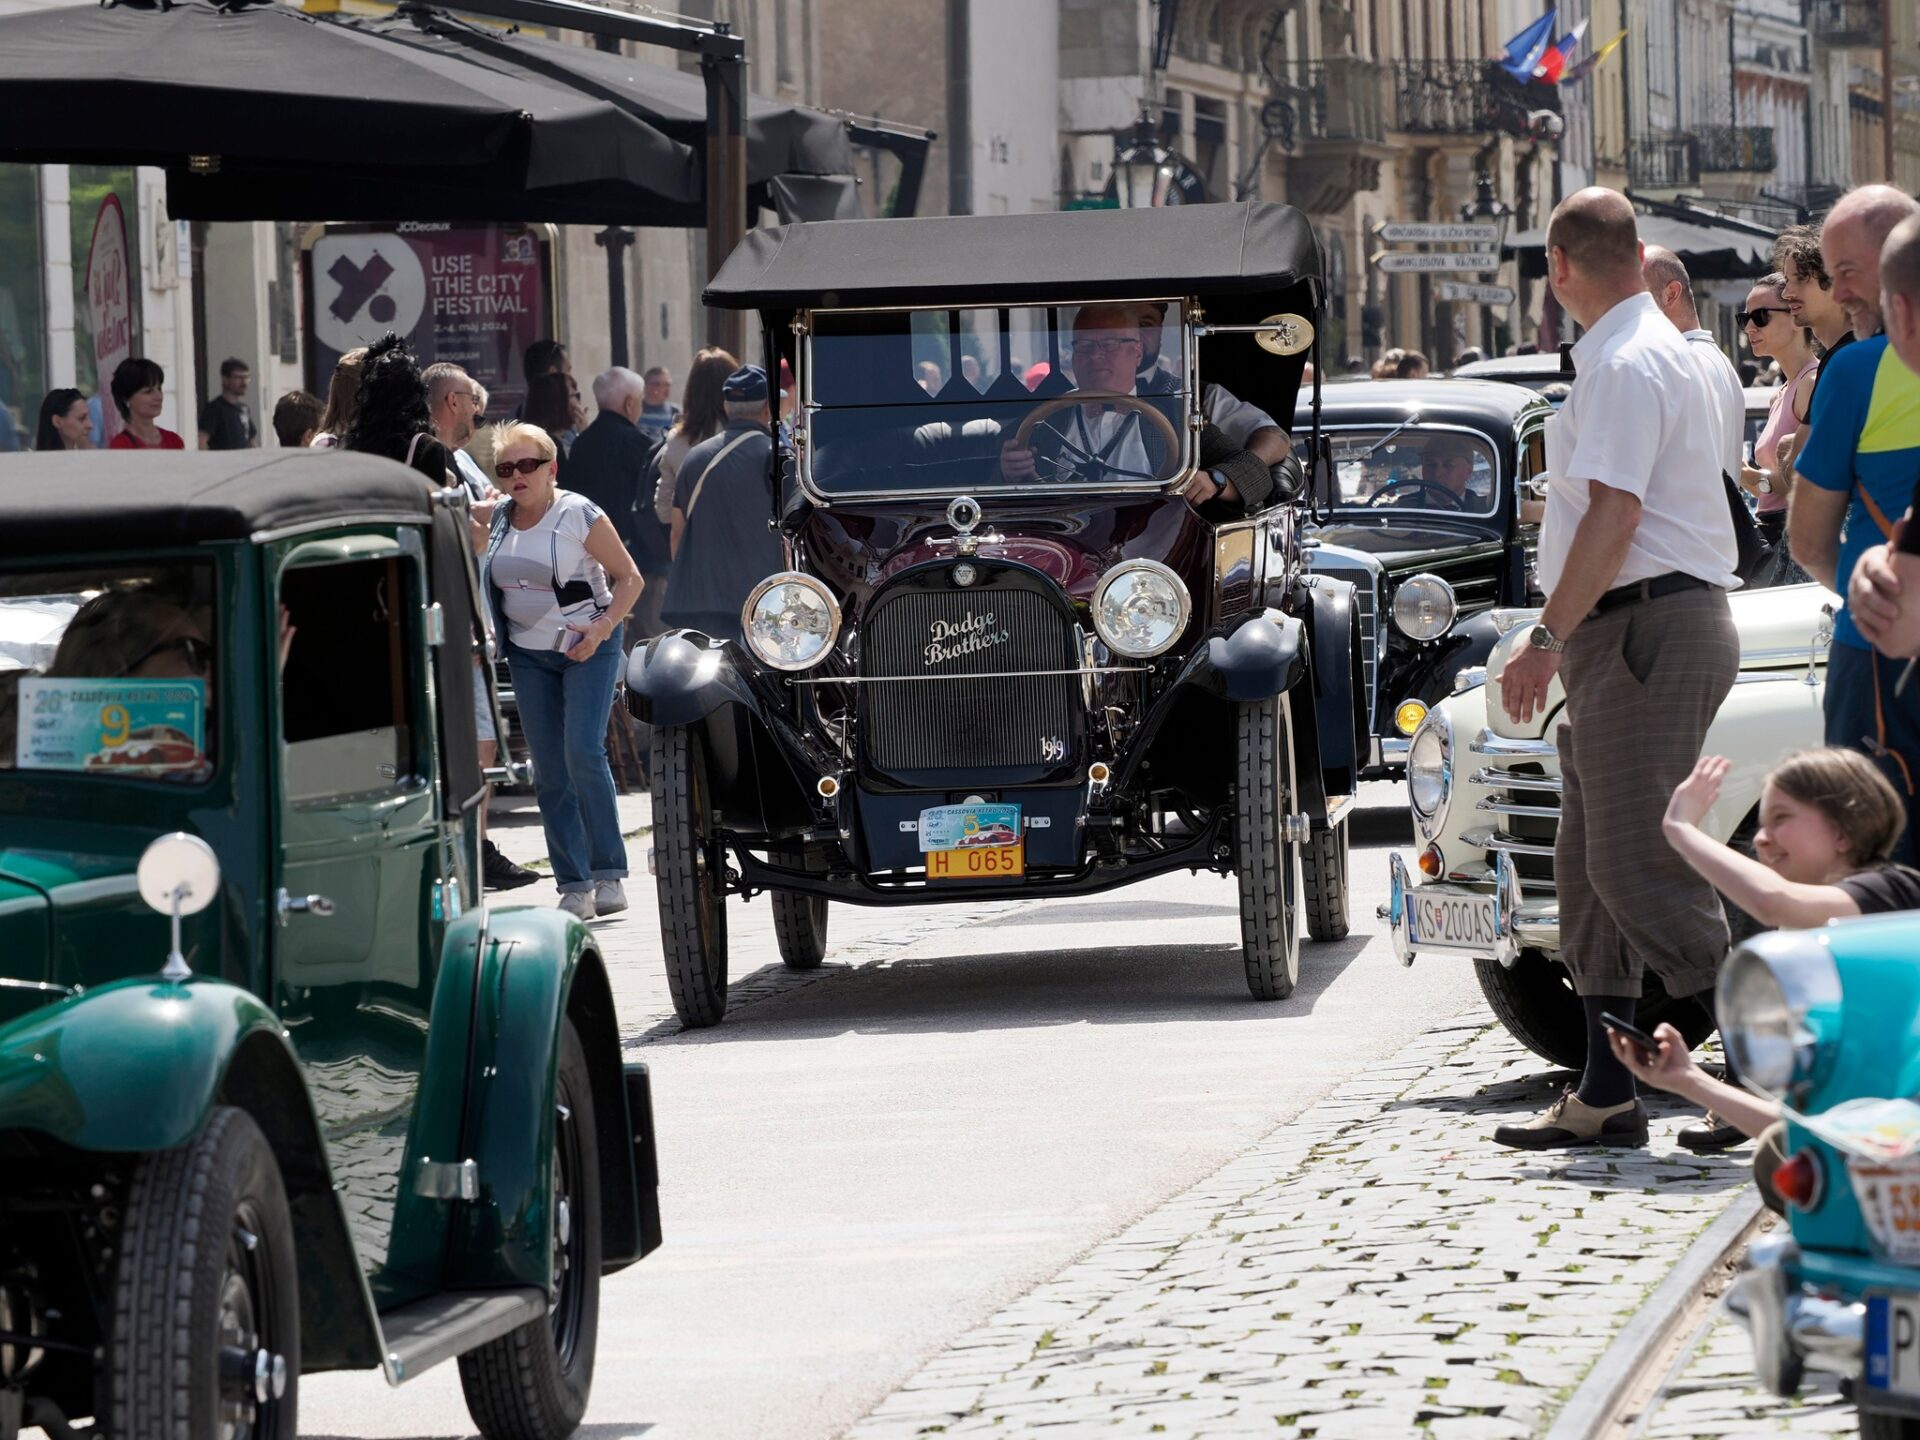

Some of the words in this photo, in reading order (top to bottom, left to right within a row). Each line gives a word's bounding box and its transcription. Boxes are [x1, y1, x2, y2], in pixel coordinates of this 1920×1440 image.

[396, 221, 451, 233] JCDecaux
[431, 254, 473, 274] USE
[431, 276, 473, 295] THE
[432, 295, 528, 316] FESTIVAL
[481, 322, 508, 332] 2024
[434, 351, 481, 361] PROGRAM
[930, 611, 997, 642] Dodge
[924, 629, 1009, 666] Brothers
[101, 704, 130, 748] 9
[1040, 735, 1064, 761] 1919
[963, 815, 980, 836] 5
[935, 851, 949, 873] H
[968, 849, 1014, 872] 065
[1415, 898, 1436, 939] KS
[1441, 901, 1494, 944] 200AS
